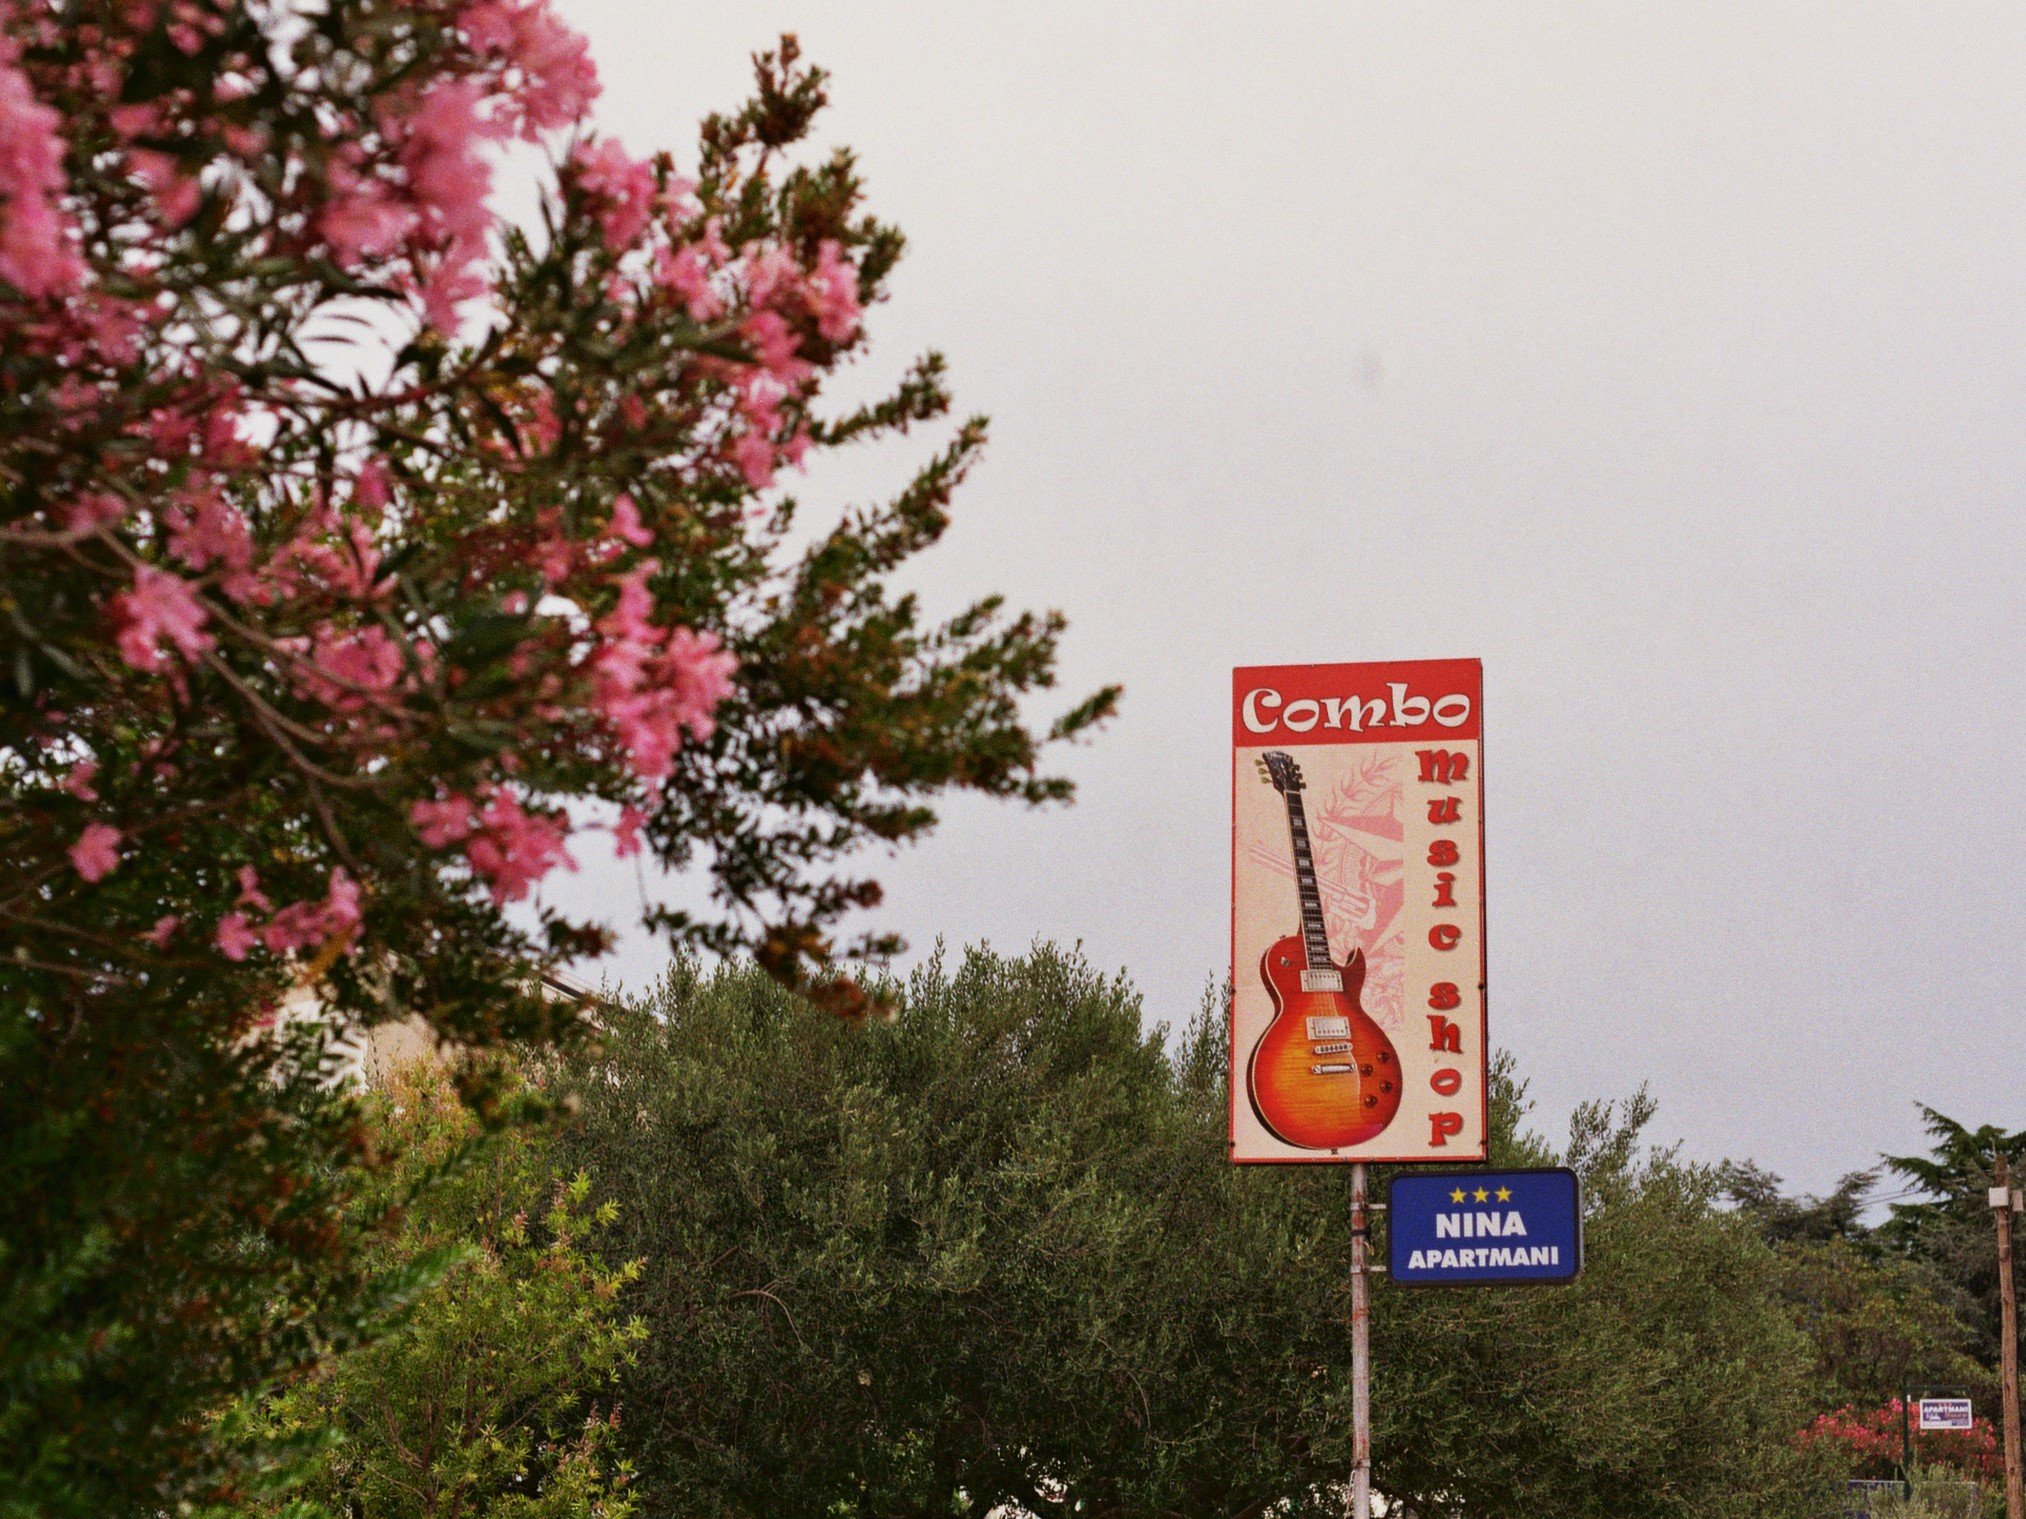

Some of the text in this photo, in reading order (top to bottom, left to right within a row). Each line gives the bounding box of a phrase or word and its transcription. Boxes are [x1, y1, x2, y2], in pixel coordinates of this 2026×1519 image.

[1242, 682, 1470, 734] Combo
[1415, 749, 1469, 1147] music shop
[1436, 1211, 1527, 1238] NINA
[1408, 1246, 1558, 1269] APARTMANI
